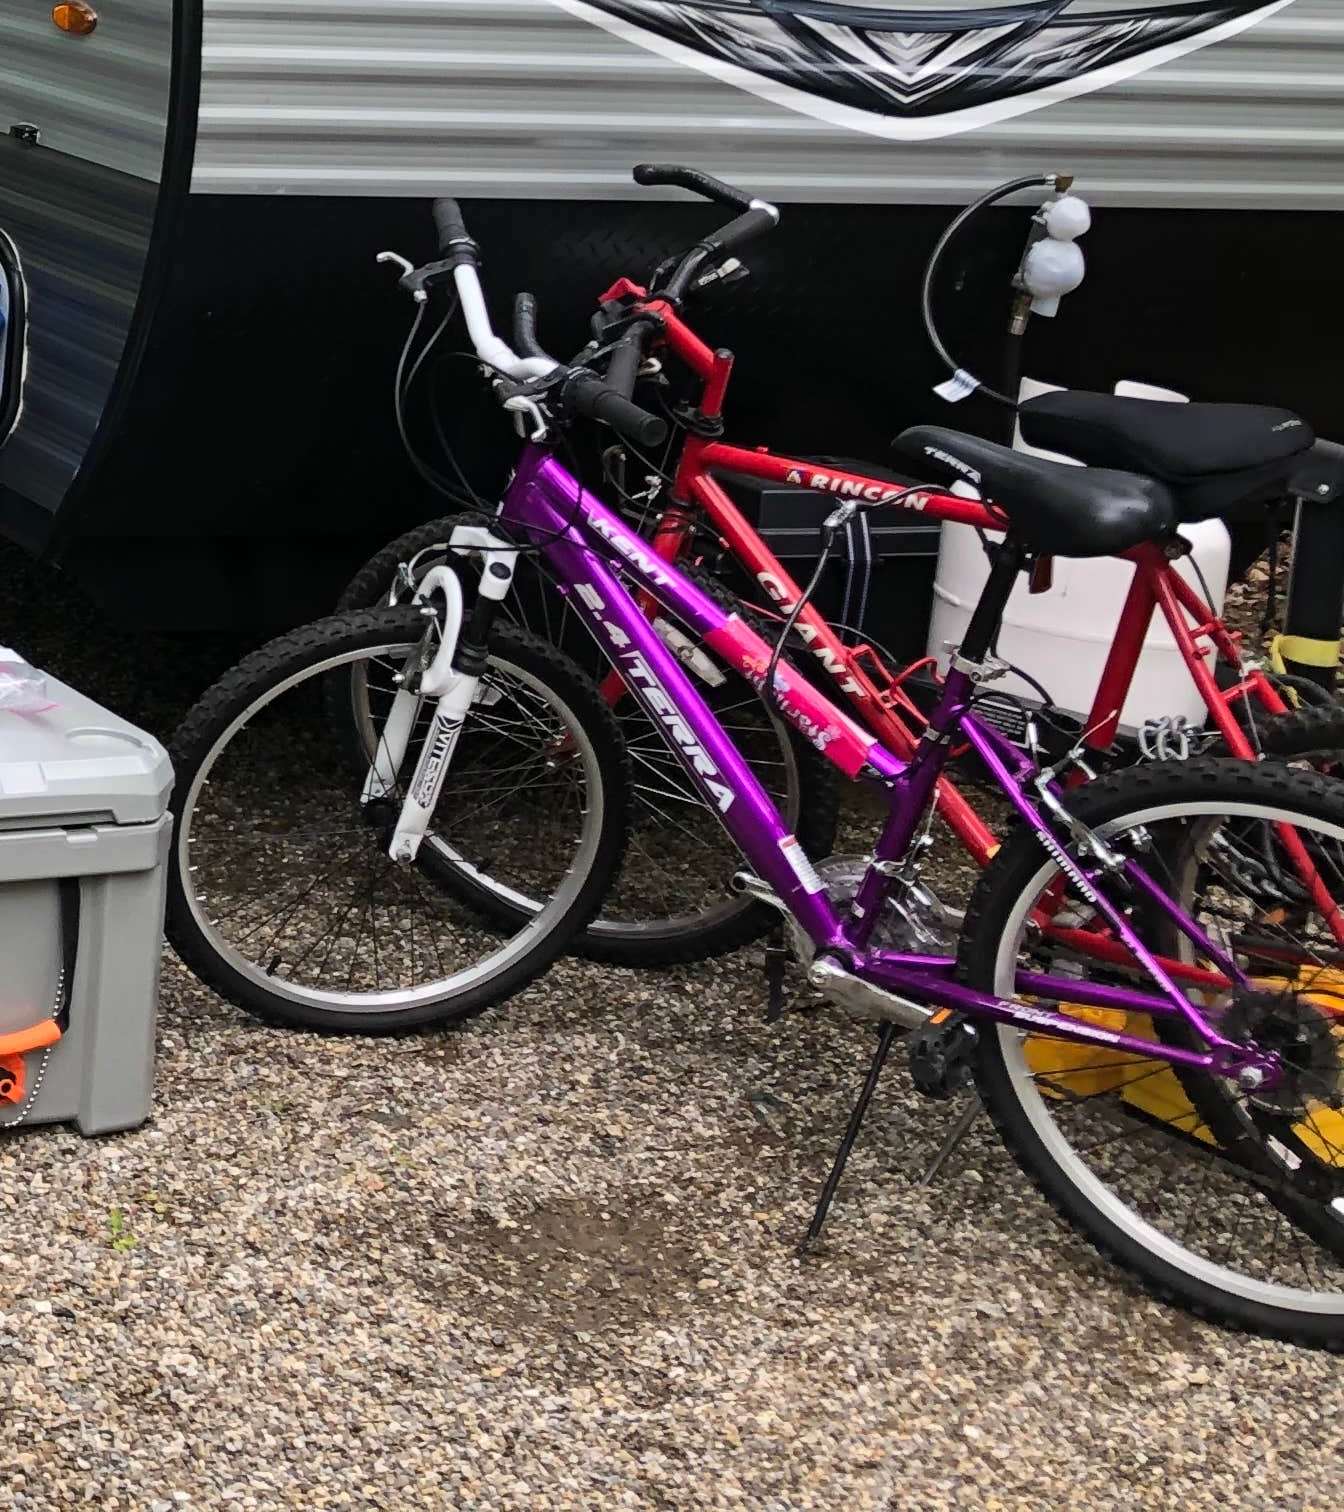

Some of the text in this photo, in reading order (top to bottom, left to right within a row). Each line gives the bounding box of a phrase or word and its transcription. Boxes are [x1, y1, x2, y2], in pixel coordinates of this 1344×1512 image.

[590, 516, 677, 589] KENT
[757, 571, 866, 697] GIANT
[574, 583, 736, 814] 2.4 TERRA
